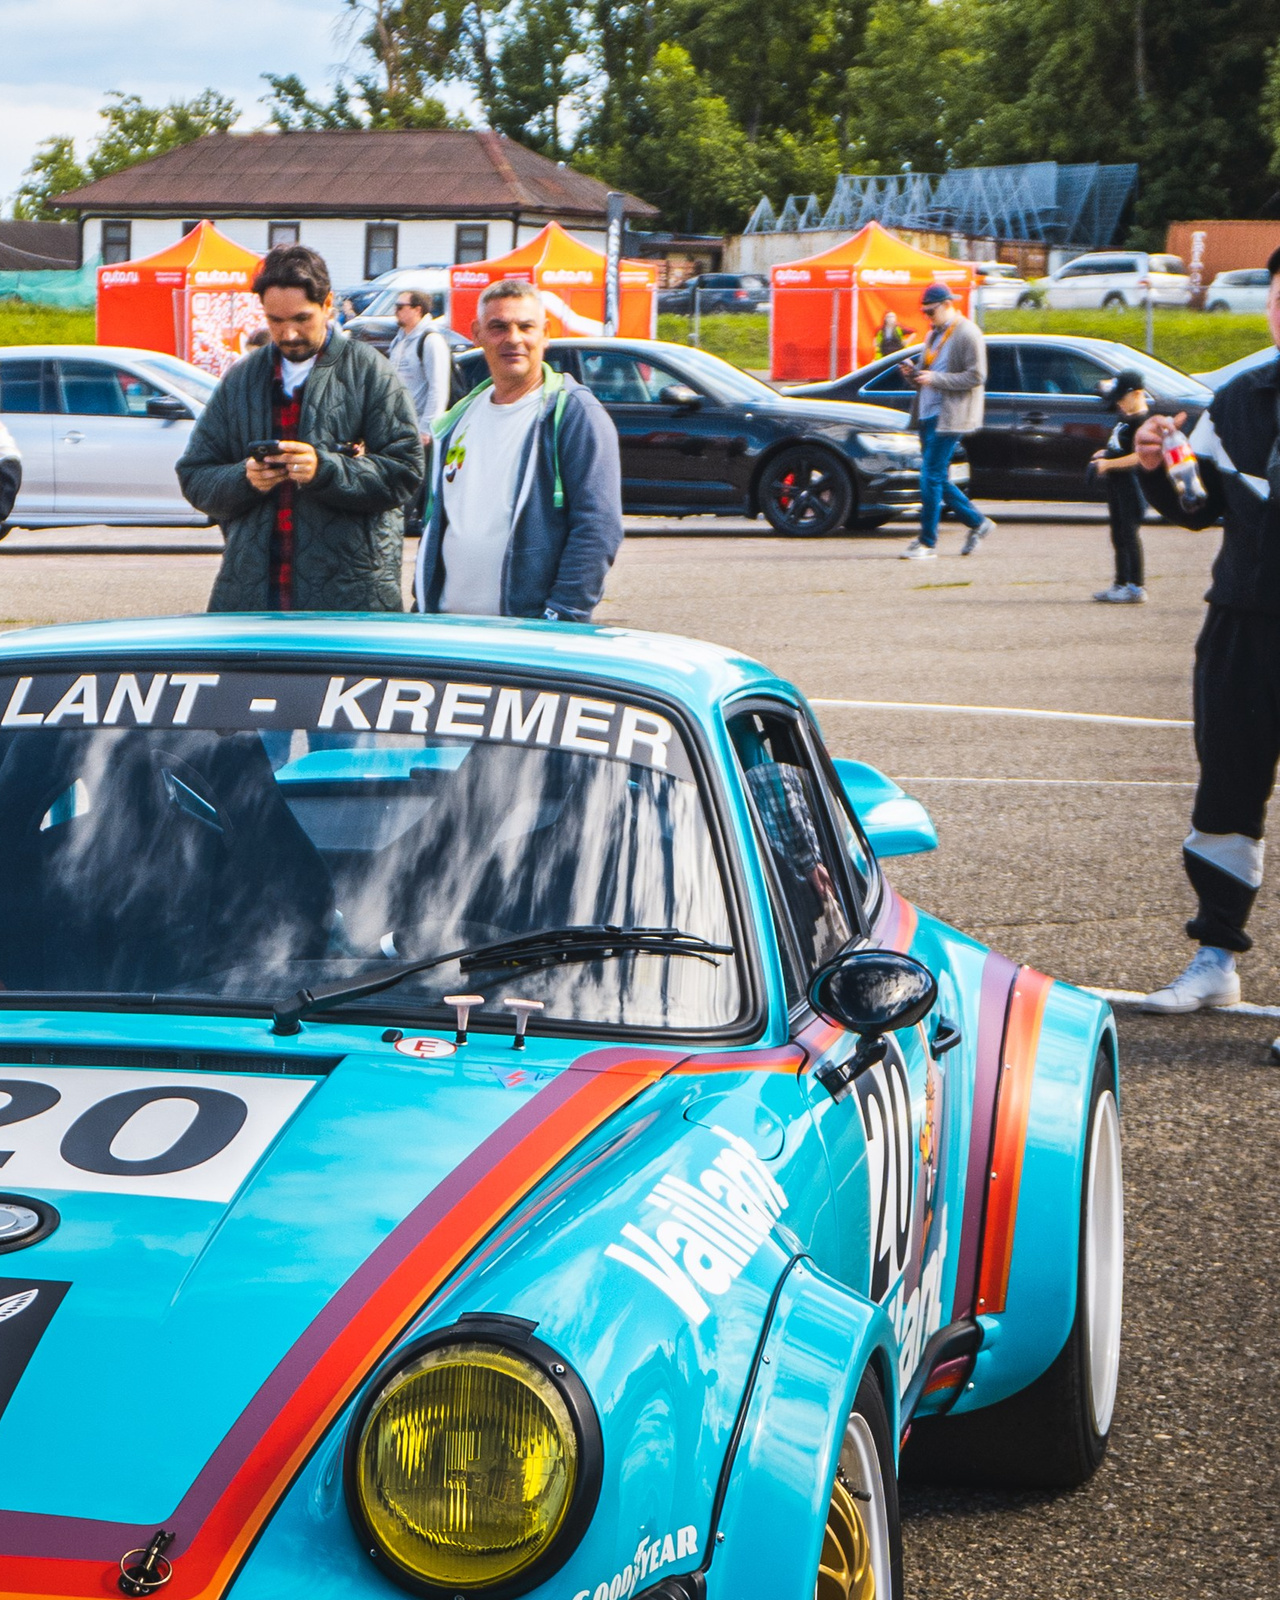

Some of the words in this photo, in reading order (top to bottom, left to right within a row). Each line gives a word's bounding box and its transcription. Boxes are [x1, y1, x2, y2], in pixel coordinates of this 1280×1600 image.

[101, 270, 140, 284] auto.ru
[195, 270, 247, 284] auto.ru
[317, 676, 673, 770] KREMER
[853, 1033, 913, 1304] 20
[603, 1125, 790, 1326] Vaillant
